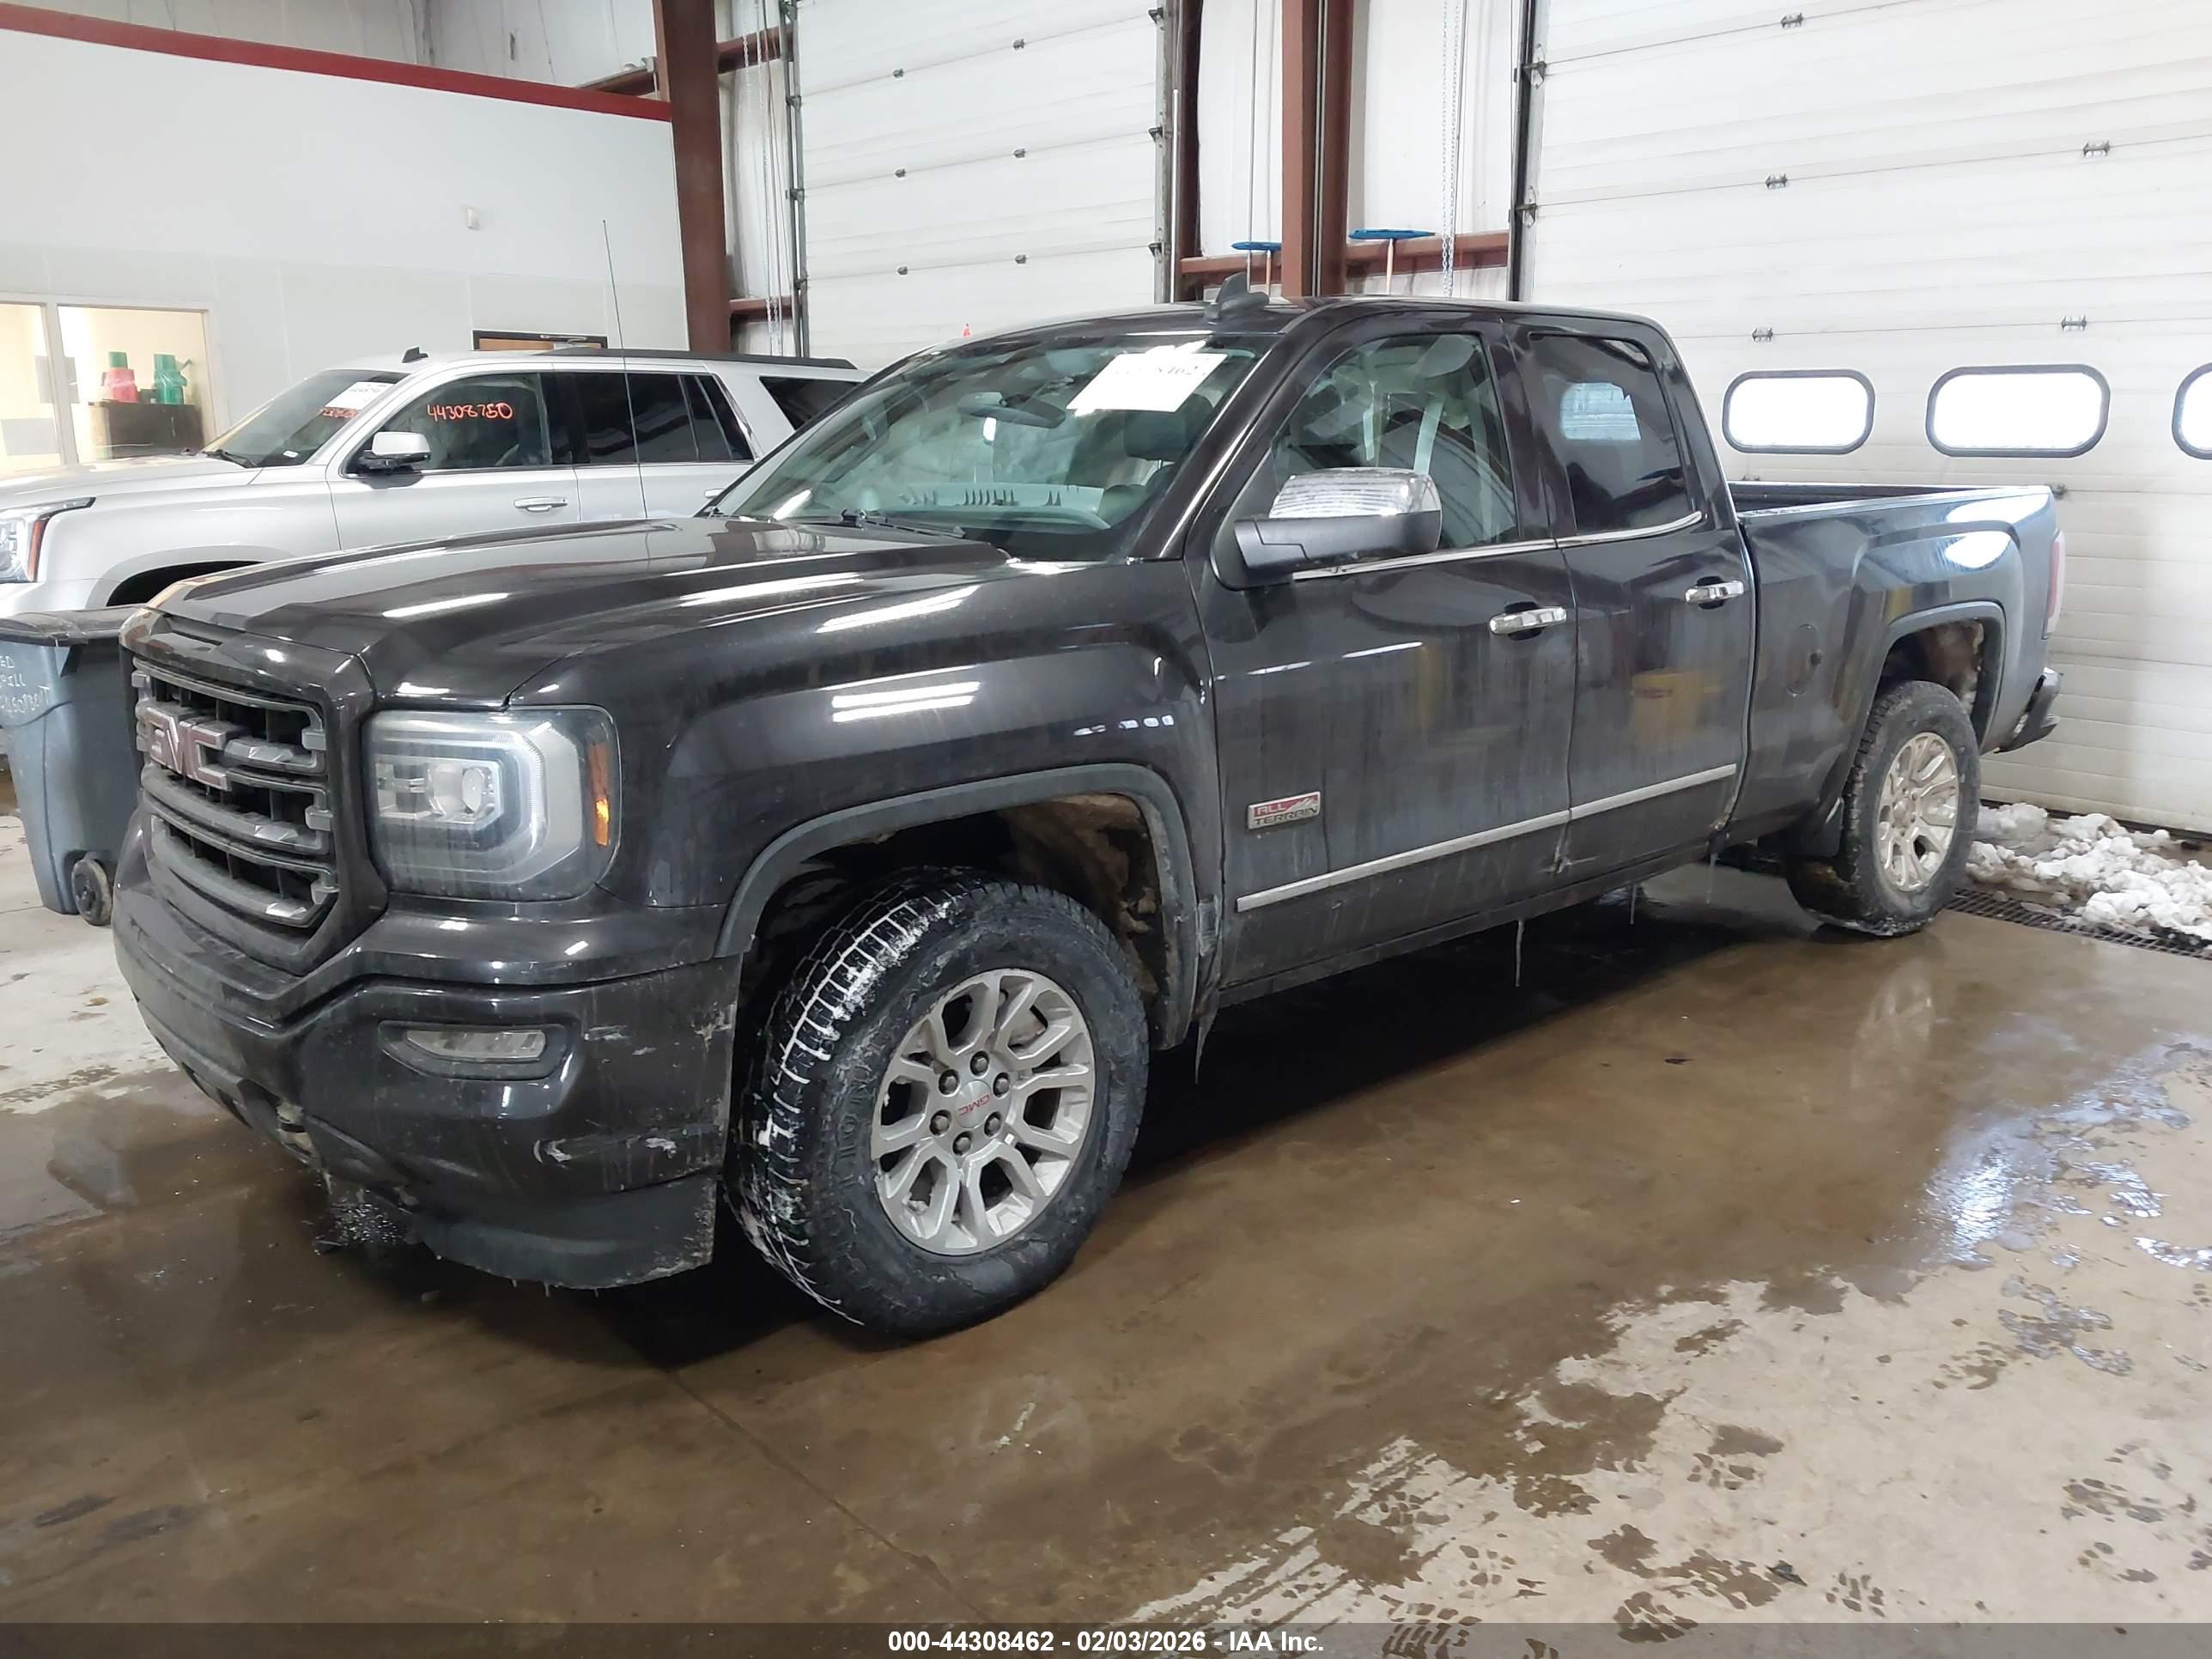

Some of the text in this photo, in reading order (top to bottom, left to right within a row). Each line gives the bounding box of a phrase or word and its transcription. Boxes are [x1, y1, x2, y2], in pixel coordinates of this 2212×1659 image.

[427, 402, 513, 422] 44308750
[144, 707, 232, 792] GMC
[1255, 806, 1317, 824] TERRAIN
[1257, 804, 1287, 815] ALL
[957, 1093, 990, 1116] GMC
